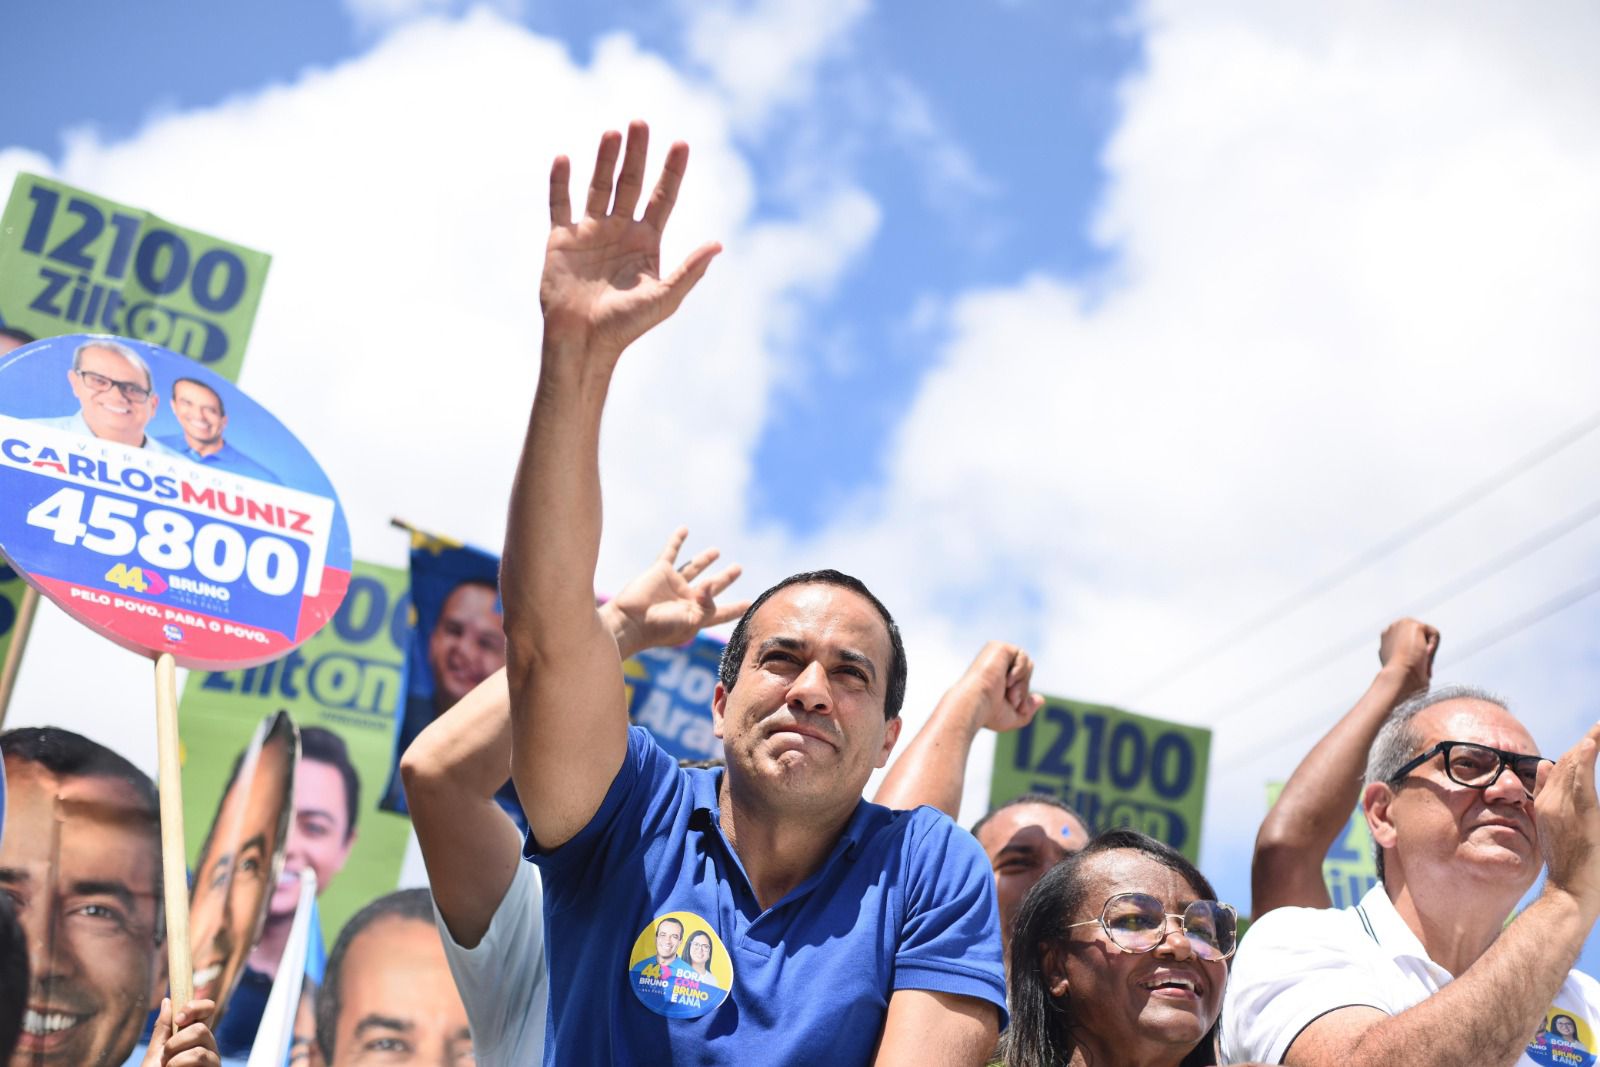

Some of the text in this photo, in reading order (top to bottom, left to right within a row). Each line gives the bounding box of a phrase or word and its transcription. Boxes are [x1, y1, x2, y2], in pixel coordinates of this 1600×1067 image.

[20, 183, 248, 314] 12100
[26, 486, 299, 596] 45800
[105, 562, 148, 593] 44
[169, 575, 230, 601] BRUNO
[70, 587, 111, 605] PELO
[114, 597, 162, 618] POVO.
[165, 609, 206, 629] PARA
[209, 621, 221, 632] O
[224, 624, 270, 644] POVO.
[1013, 705, 1196, 801] 12100
[639, 977, 669, 988] BRUNO
[671, 994, 701, 1008] E ANA
[673, 985, 708, 1000] BRUNO
[675, 978, 701, 989] COM
